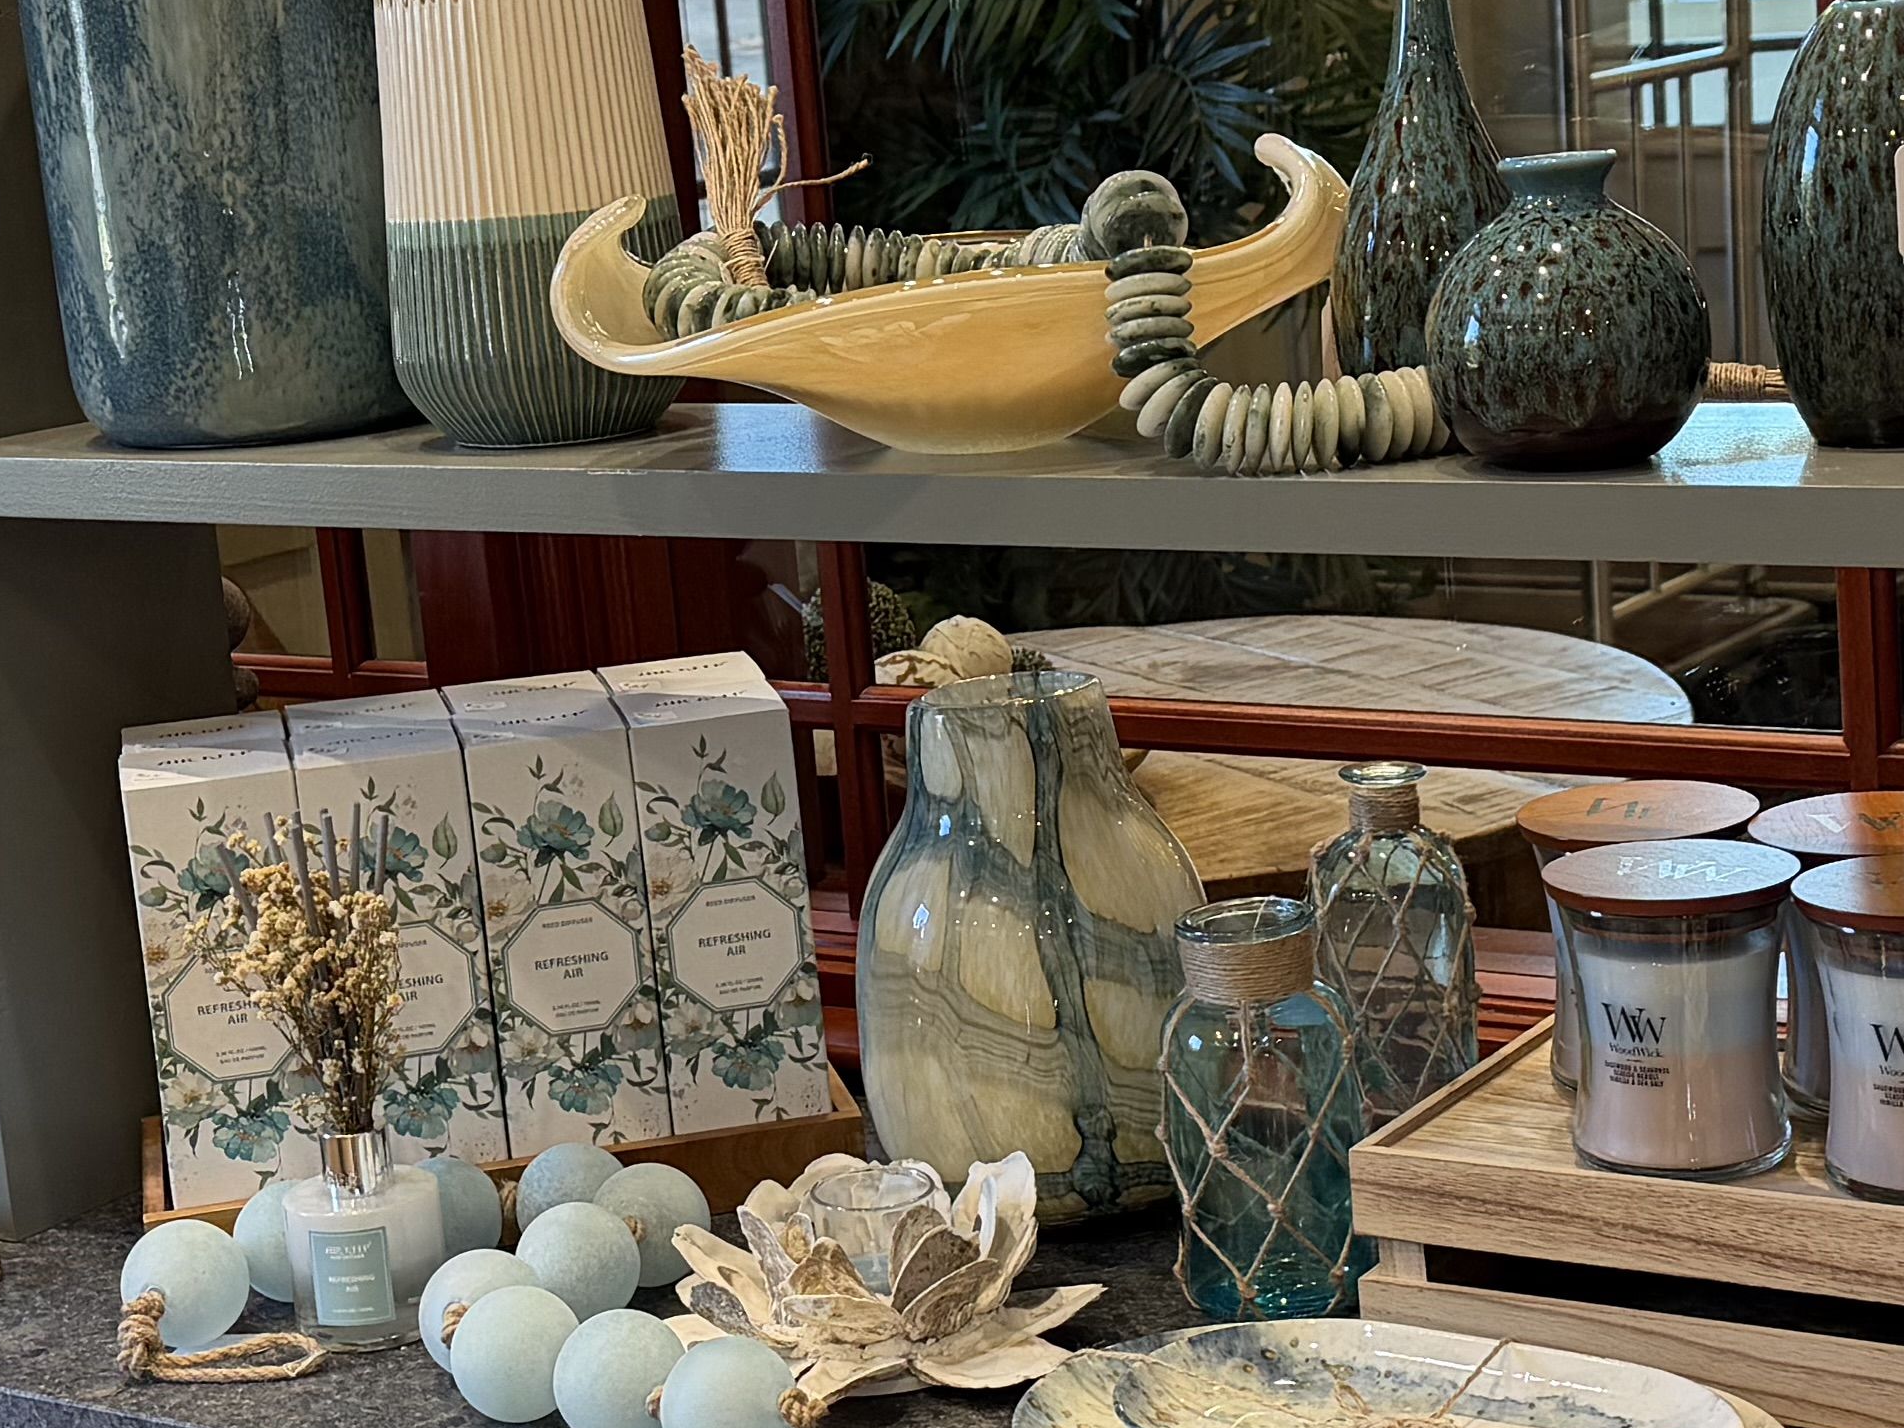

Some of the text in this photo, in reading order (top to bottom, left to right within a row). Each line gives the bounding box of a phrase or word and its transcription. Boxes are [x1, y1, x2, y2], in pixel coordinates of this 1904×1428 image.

[698, 928, 771, 948] REFRESHING
[726, 944, 746, 956] AIR
[534, 951, 609, 971] REFRESHING
[563, 967, 584, 979] AIR
[228, 1013, 248, 1024] AIR
[1609, 1042, 1664, 1057] WoodWick
